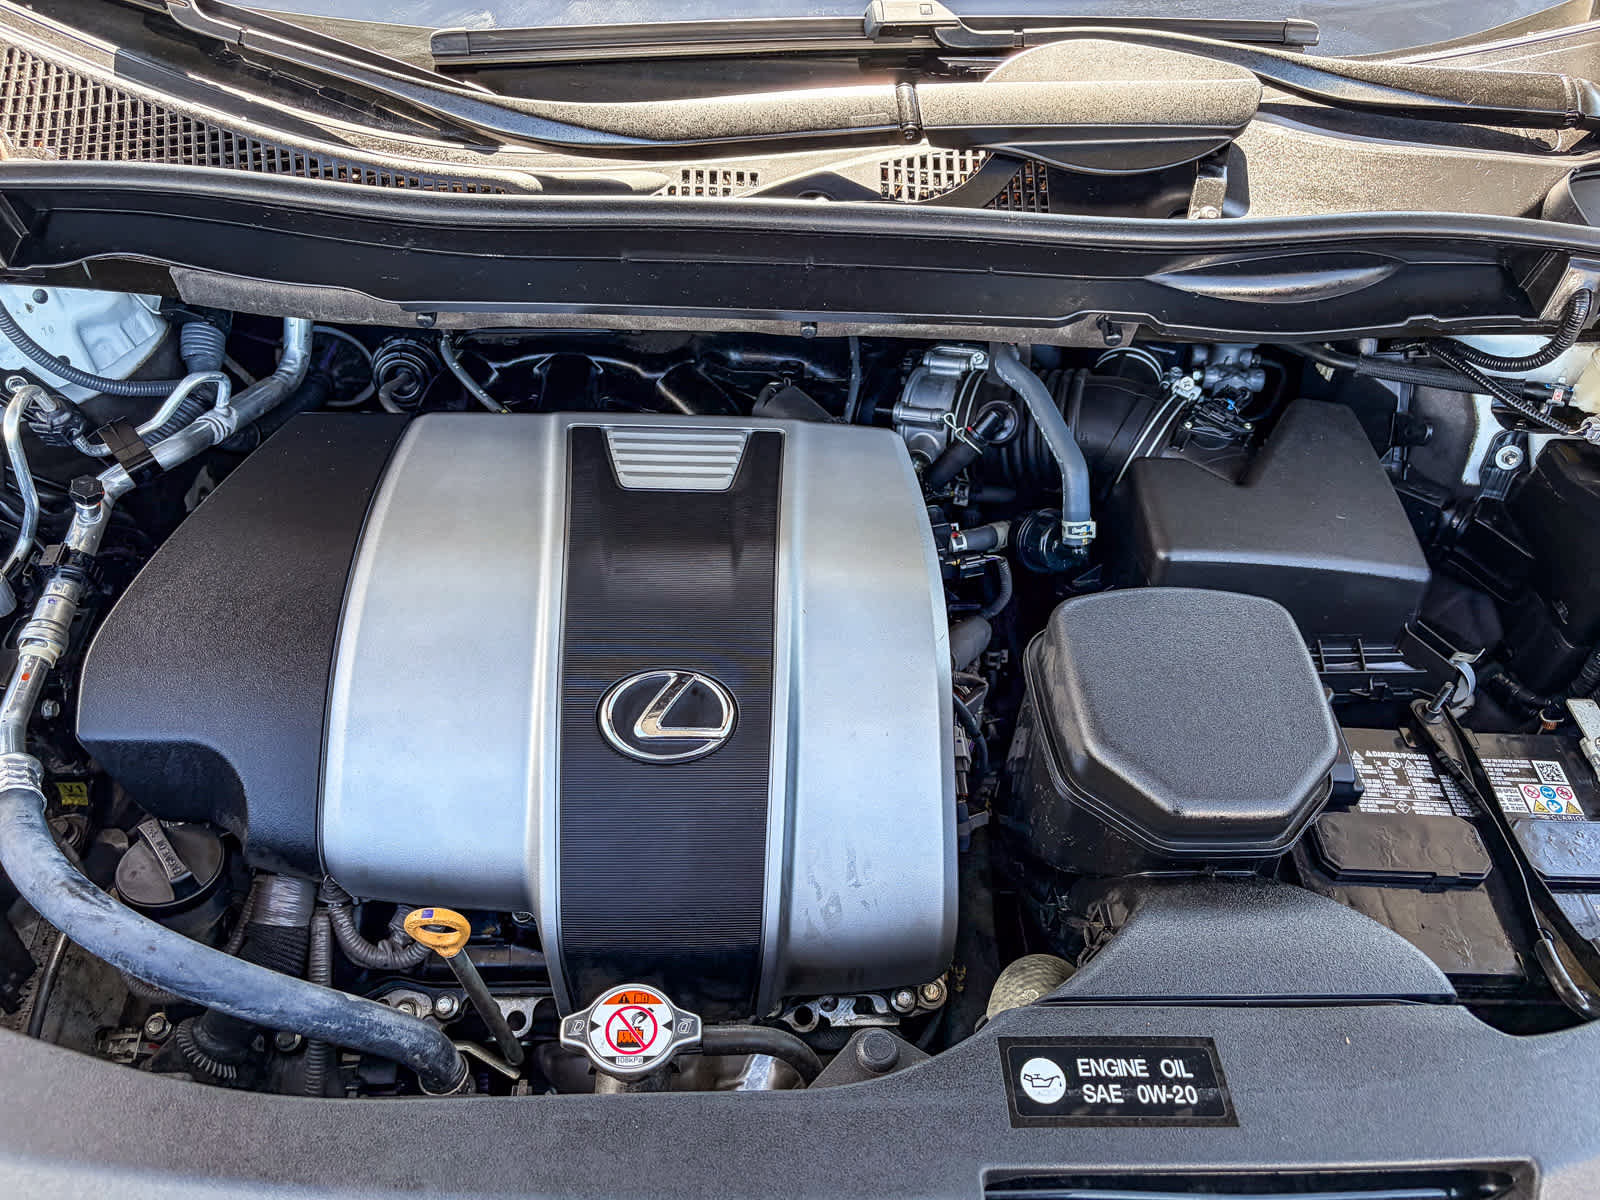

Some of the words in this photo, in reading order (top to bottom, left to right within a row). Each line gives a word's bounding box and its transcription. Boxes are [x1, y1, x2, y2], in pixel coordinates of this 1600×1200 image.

[1076, 1058, 1149, 1077] ENGINE
[1160, 1059, 1194, 1079] OIL
[1082, 1084, 1124, 1104] SAE
[1137, 1084, 1198, 1104] 0W-20
